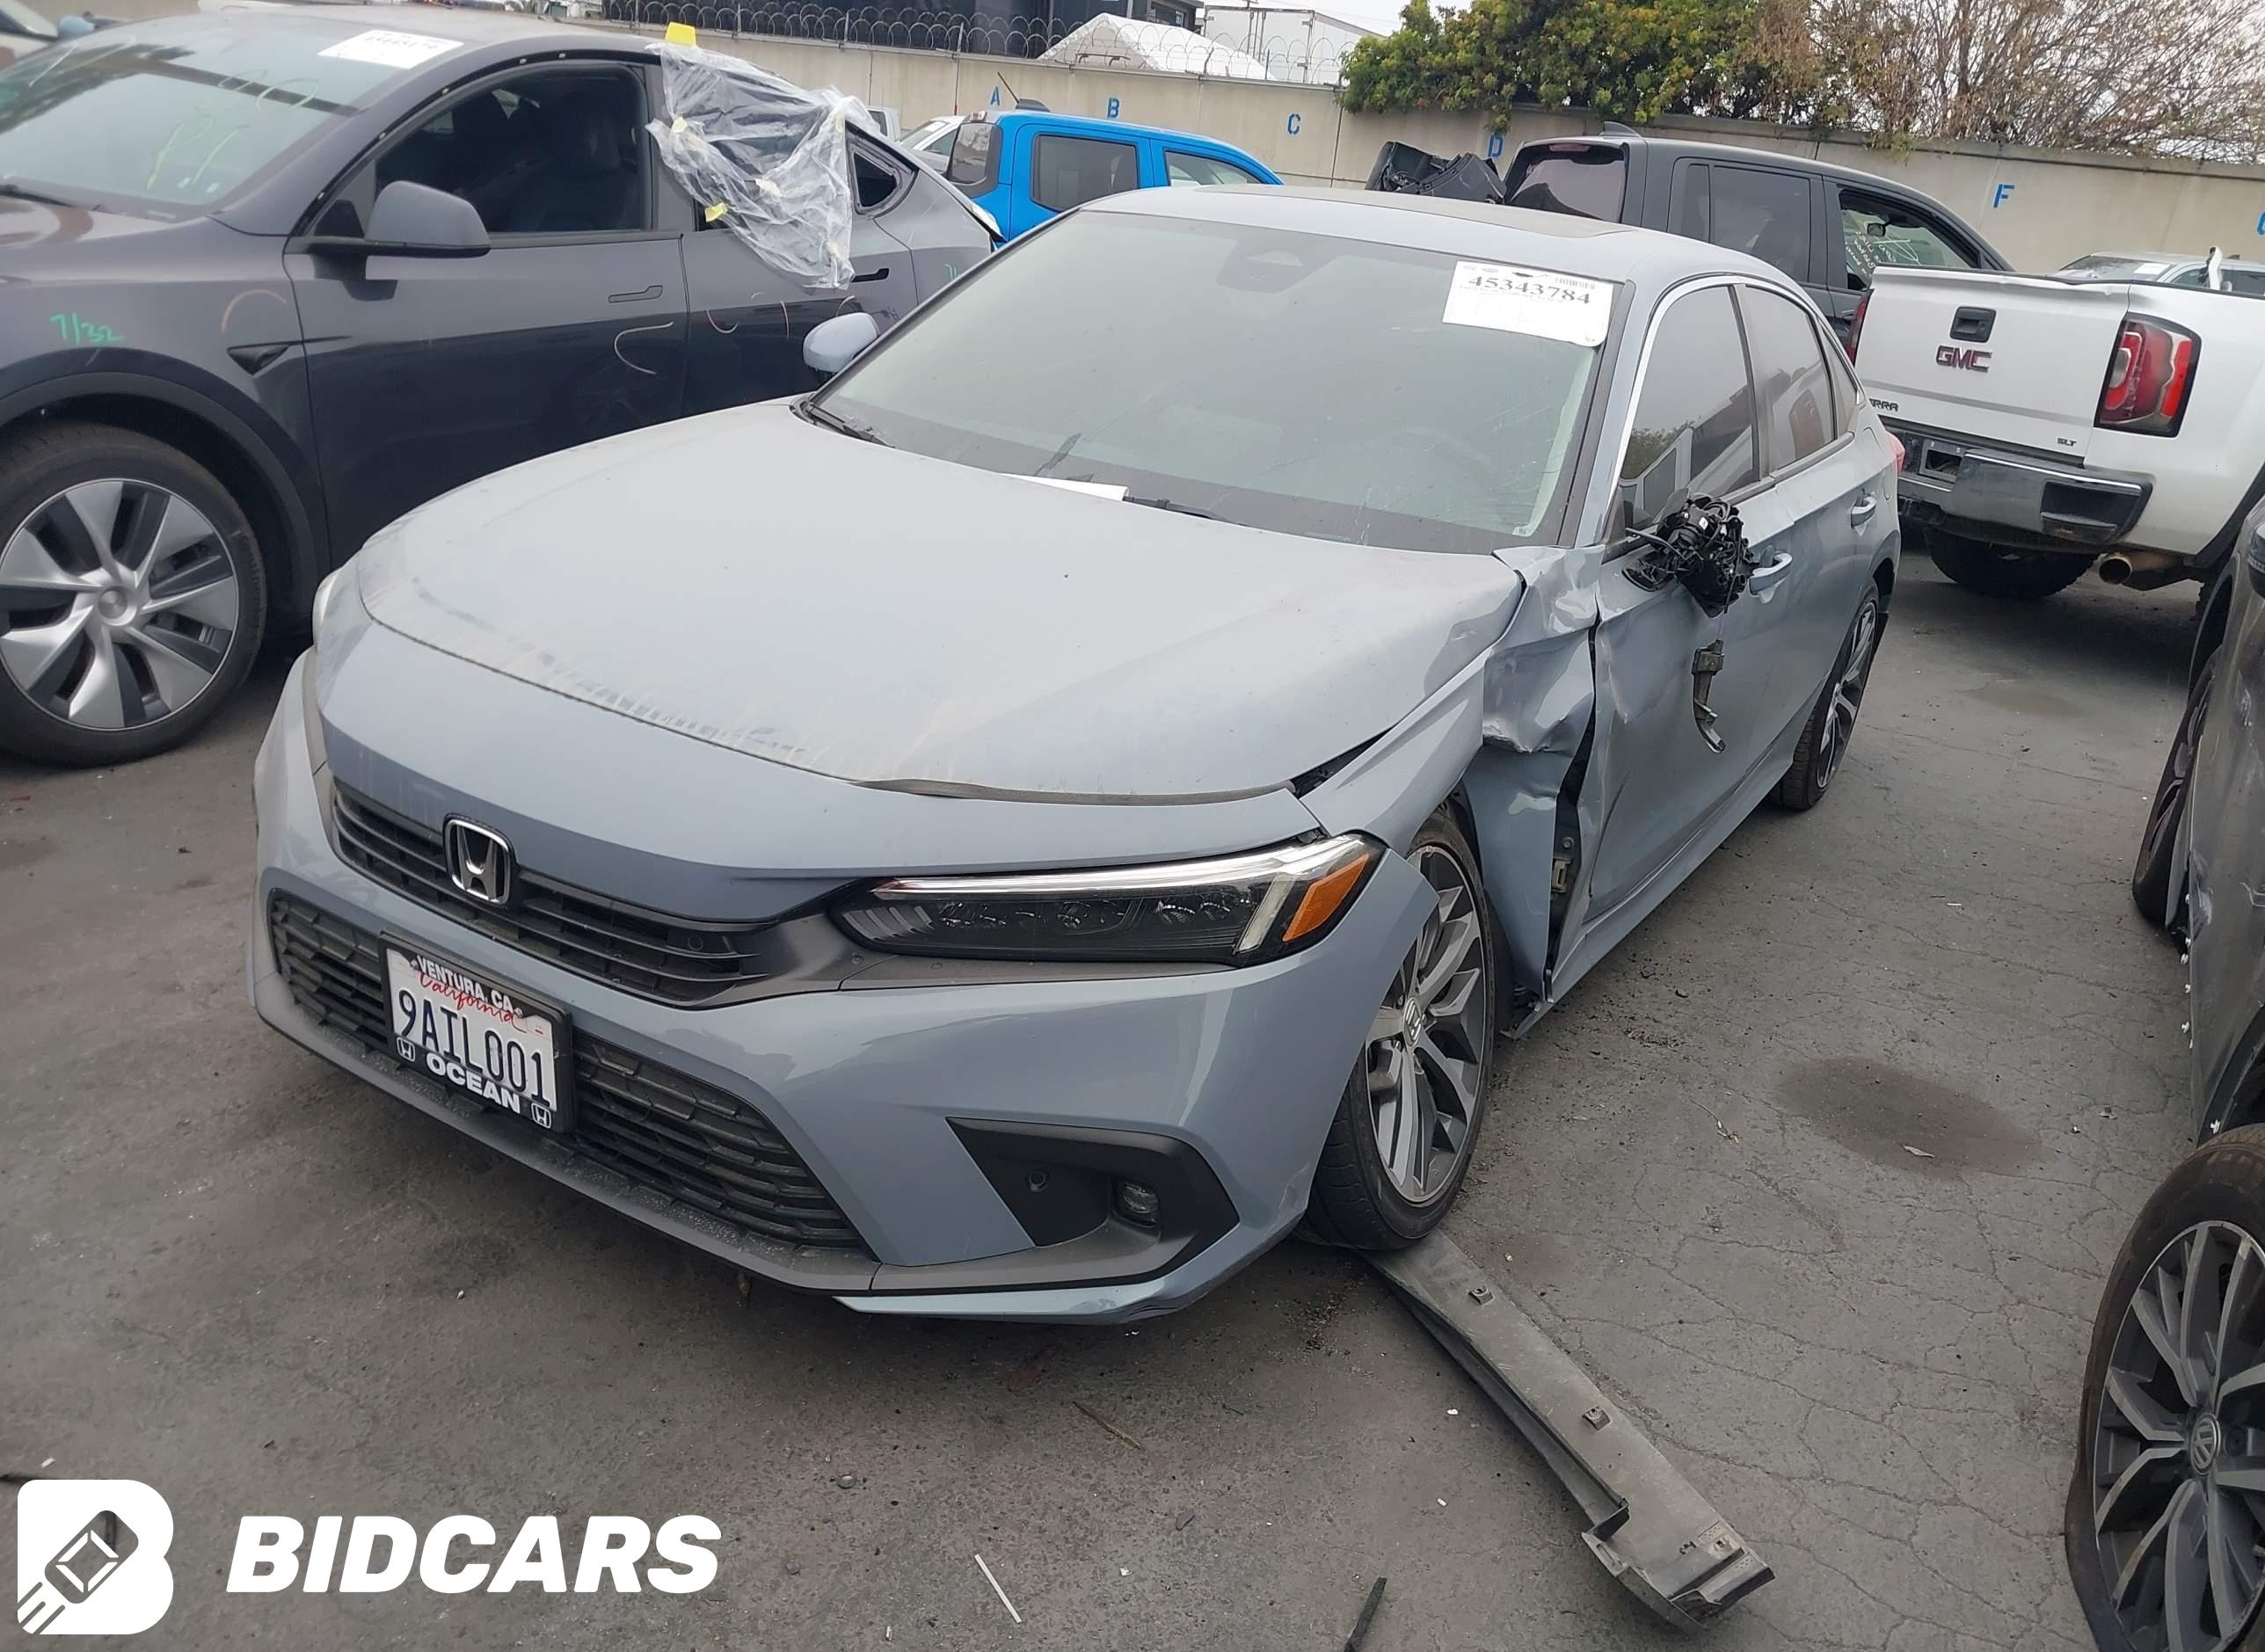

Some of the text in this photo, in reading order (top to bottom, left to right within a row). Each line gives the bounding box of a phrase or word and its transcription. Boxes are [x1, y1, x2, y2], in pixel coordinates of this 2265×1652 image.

[990, 85, 1001, 106] A
[1107, 97, 1120, 119] B
[1286, 113, 1301, 135] C
[1487, 133, 1505, 157] D
[1992, 183, 2015, 209] F
[1468, 275, 1591, 304] 45343784
[1936, 345, 1993, 374] GMC
[490, 987, 514, 1015] CA
[398, 989, 550, 1108] 9AIL001
[426, 1052, 521, 1115] OCEAN
